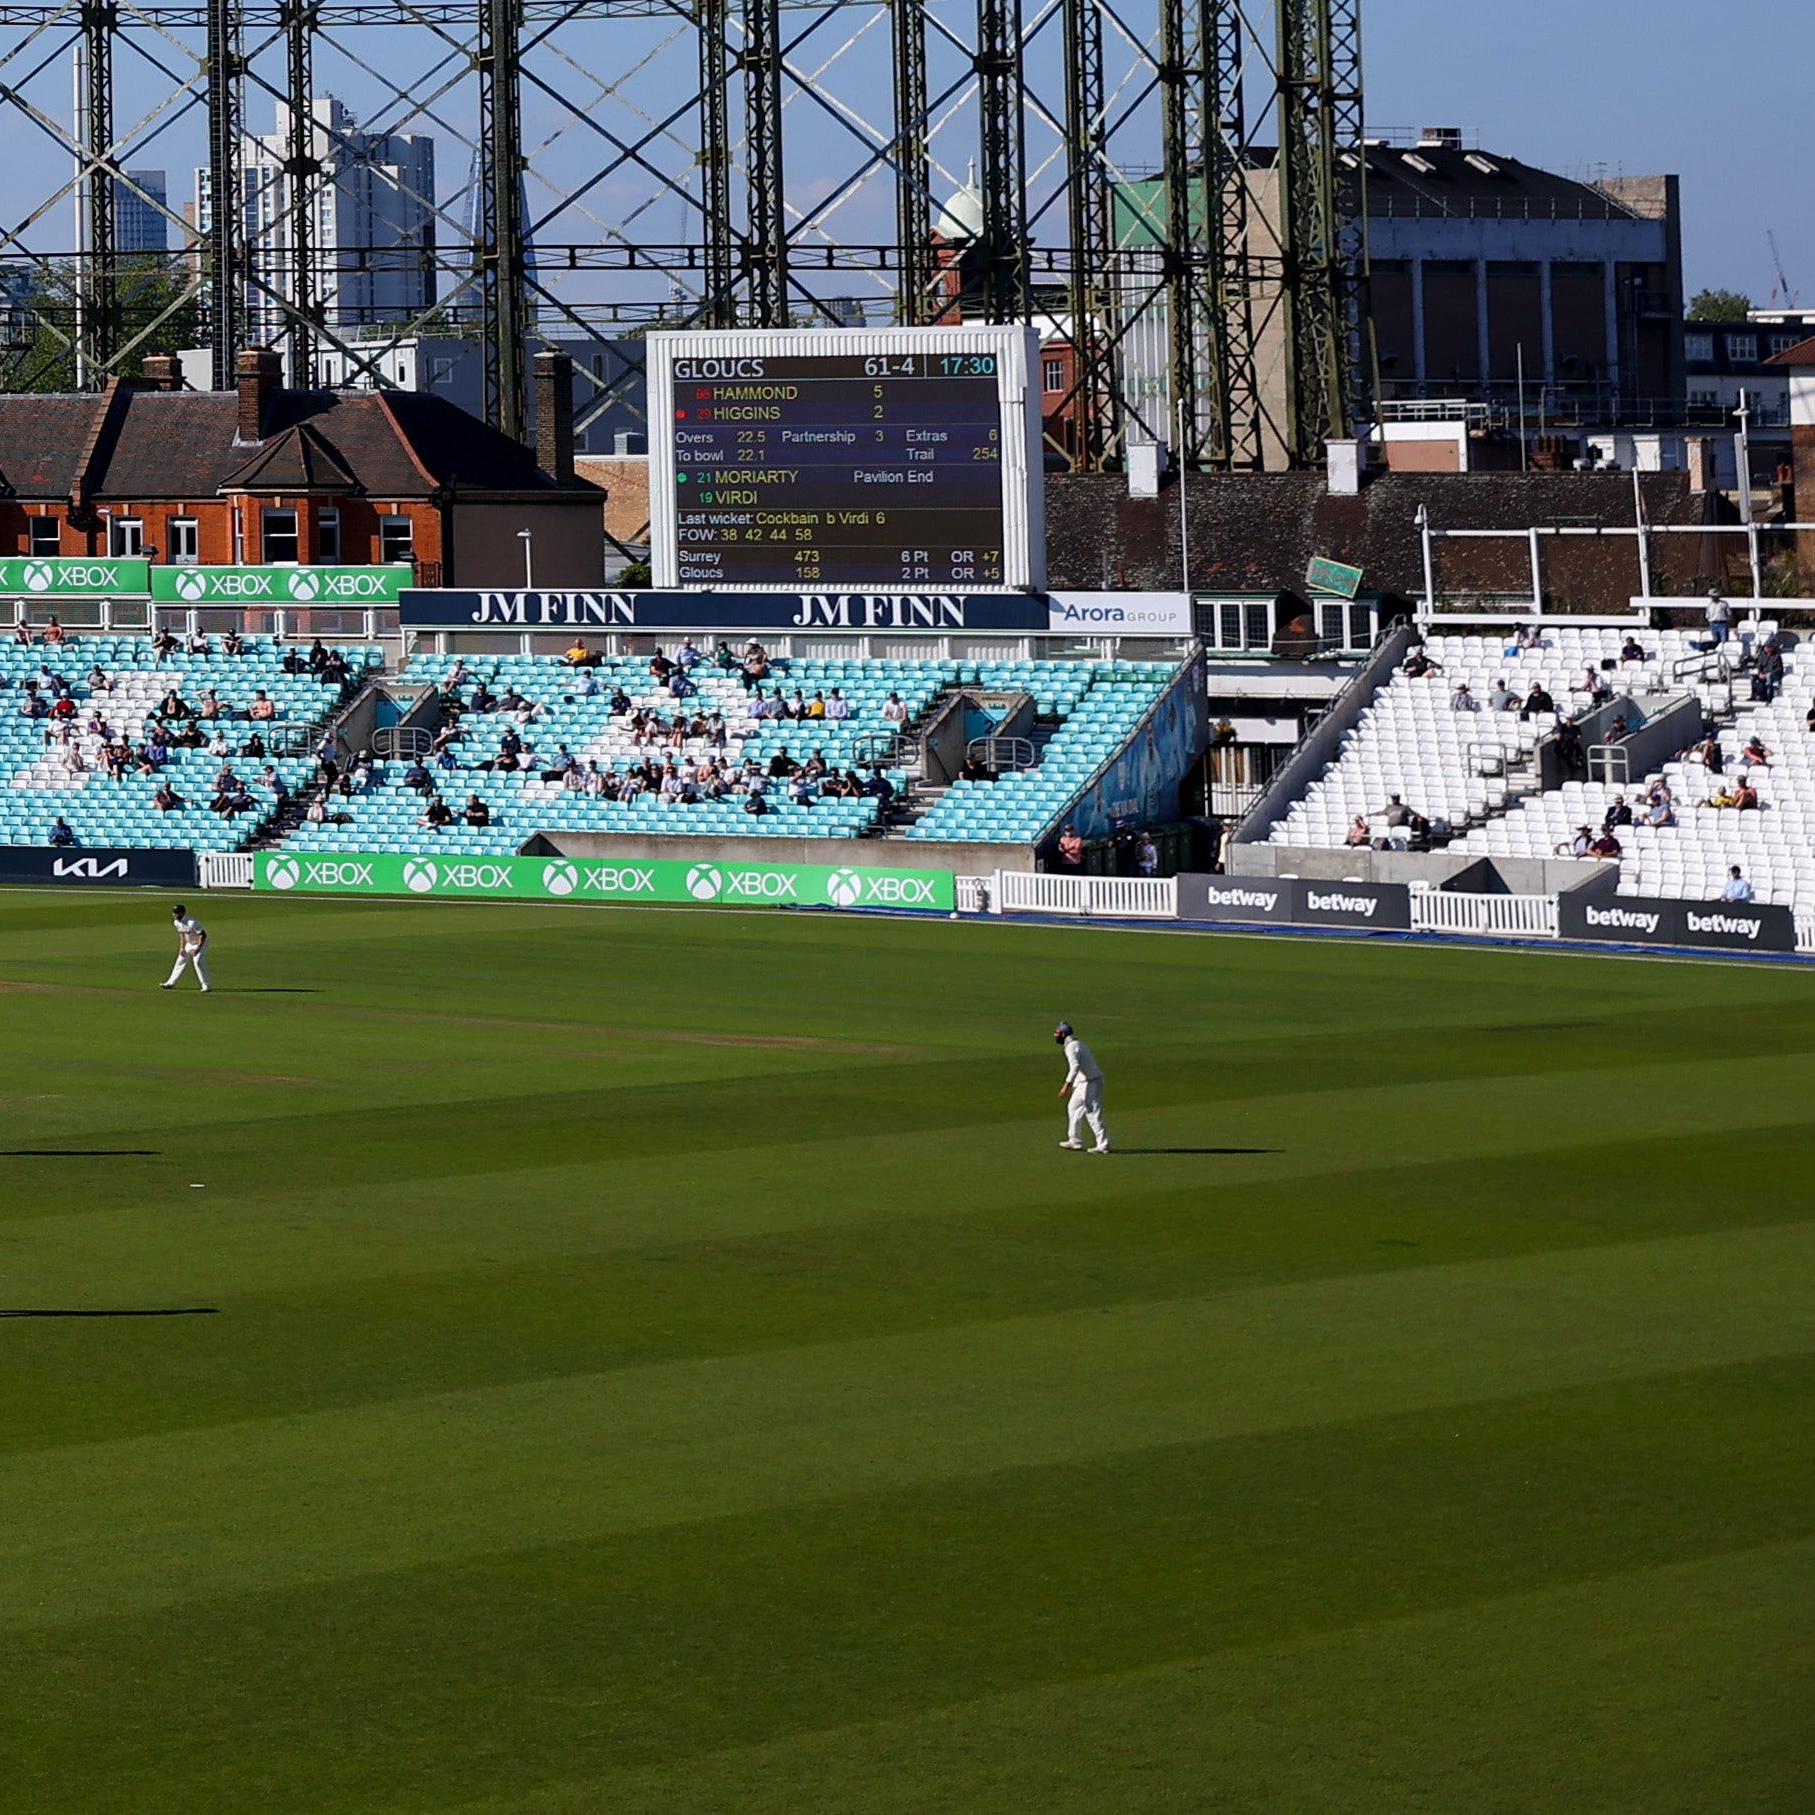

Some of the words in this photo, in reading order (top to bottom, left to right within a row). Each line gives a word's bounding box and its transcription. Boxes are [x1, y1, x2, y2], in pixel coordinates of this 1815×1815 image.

[674, 359, 765, 378] GLOUCS
[864, 357, 916, 376] 61-4
[940, 356, 995, 375] 17:30
[713, 386, 799, 400] HAMMOND
[873, 384, 883, 398] 5
[696, 408, 712, 420] 29
[713, 406, 781, 420] HIGGINS
[873, 404, 884, 419] 2
[675, 432, 714, 444] Overs
[736, 431, 766, 443] 22.5
[781, 430, 856, 445] Partnership
[875, 429, 884, 442] 3
[905, 429, 948, 442] Extras
[988, 428, 998, 441] 6
[676, 449, 691, 462] To
[695, 449, 724, 462] bowl
[737, 448, 765, 461] 22.1
[905, 448, 935, 460] Trail
[972, 447, 999, 460] 254
[697, 472, 711, 484] 21
[715, 470, 799, 484] MORIARTY
[853, 470, 904, 483] Pavilion
[907, 470, 934, 483] End
[698, 491, 713, 504] 19
[715, 490, 758, 505] VIRDI
[678, 512, 706, 525] Last
[708, 512, 754, 525] wicket:
[756, 512, 819, 525] Cockbain
[826, 512, 836, 525] b
[838, 511, 870, 525] Virdi
[875, 512, 886, 525] 6
[678, 529, 718, 541] FOW:
[721, 528, 738, 541] 38
[745, 528, 763, 541] 42
[769, 528, 787, 541] 44
[795, 528, 813, 541] 58
[678, 550, 722, 565] Surrey
[794, 550, 821, 563] 473
[900, 550, 910, 563] 6
[914, 550, 929, 563] Pt
[950, 550, 974, 563] OR
[982, 550, 1000, 563] +7
[57, 565, 119, 586] XBOX
[679, 566, 724, 579] Gloucs
[795, 566, 821, 579] 158
[901, 567, 911, 579] 2
[914, 567, 929, 579] Pt
[951, 567, 975, 579] OR
[982, 567, 1000, 579] +5
[210, 574, 273, 596] XBOX
[323, 574, 388, 596] XBOX
[471, 593, 529, 623] JM
[538, 593, 639, 624] FINN
[792, 594, 852, 627] JM
[861, 594, 969, 628] FINN
[1063, 603, 1125, 622] Arora
[1127, 612, 1177, 622] GROUP
[304, 862, 374, 885] XBOX
[442, 864, 513, 888] XBOX
[583, 867, 655, 892] XBOX
[726, 871, 797, 897] XBOX
[865, 876, 936, 904] XBOX
[1208, 886, 1278, 912] betway
[1307, 890, 1378, 917] betway
[1585, 905, 1660, 933] betway
[1686, 911, 1762, 939] betway
